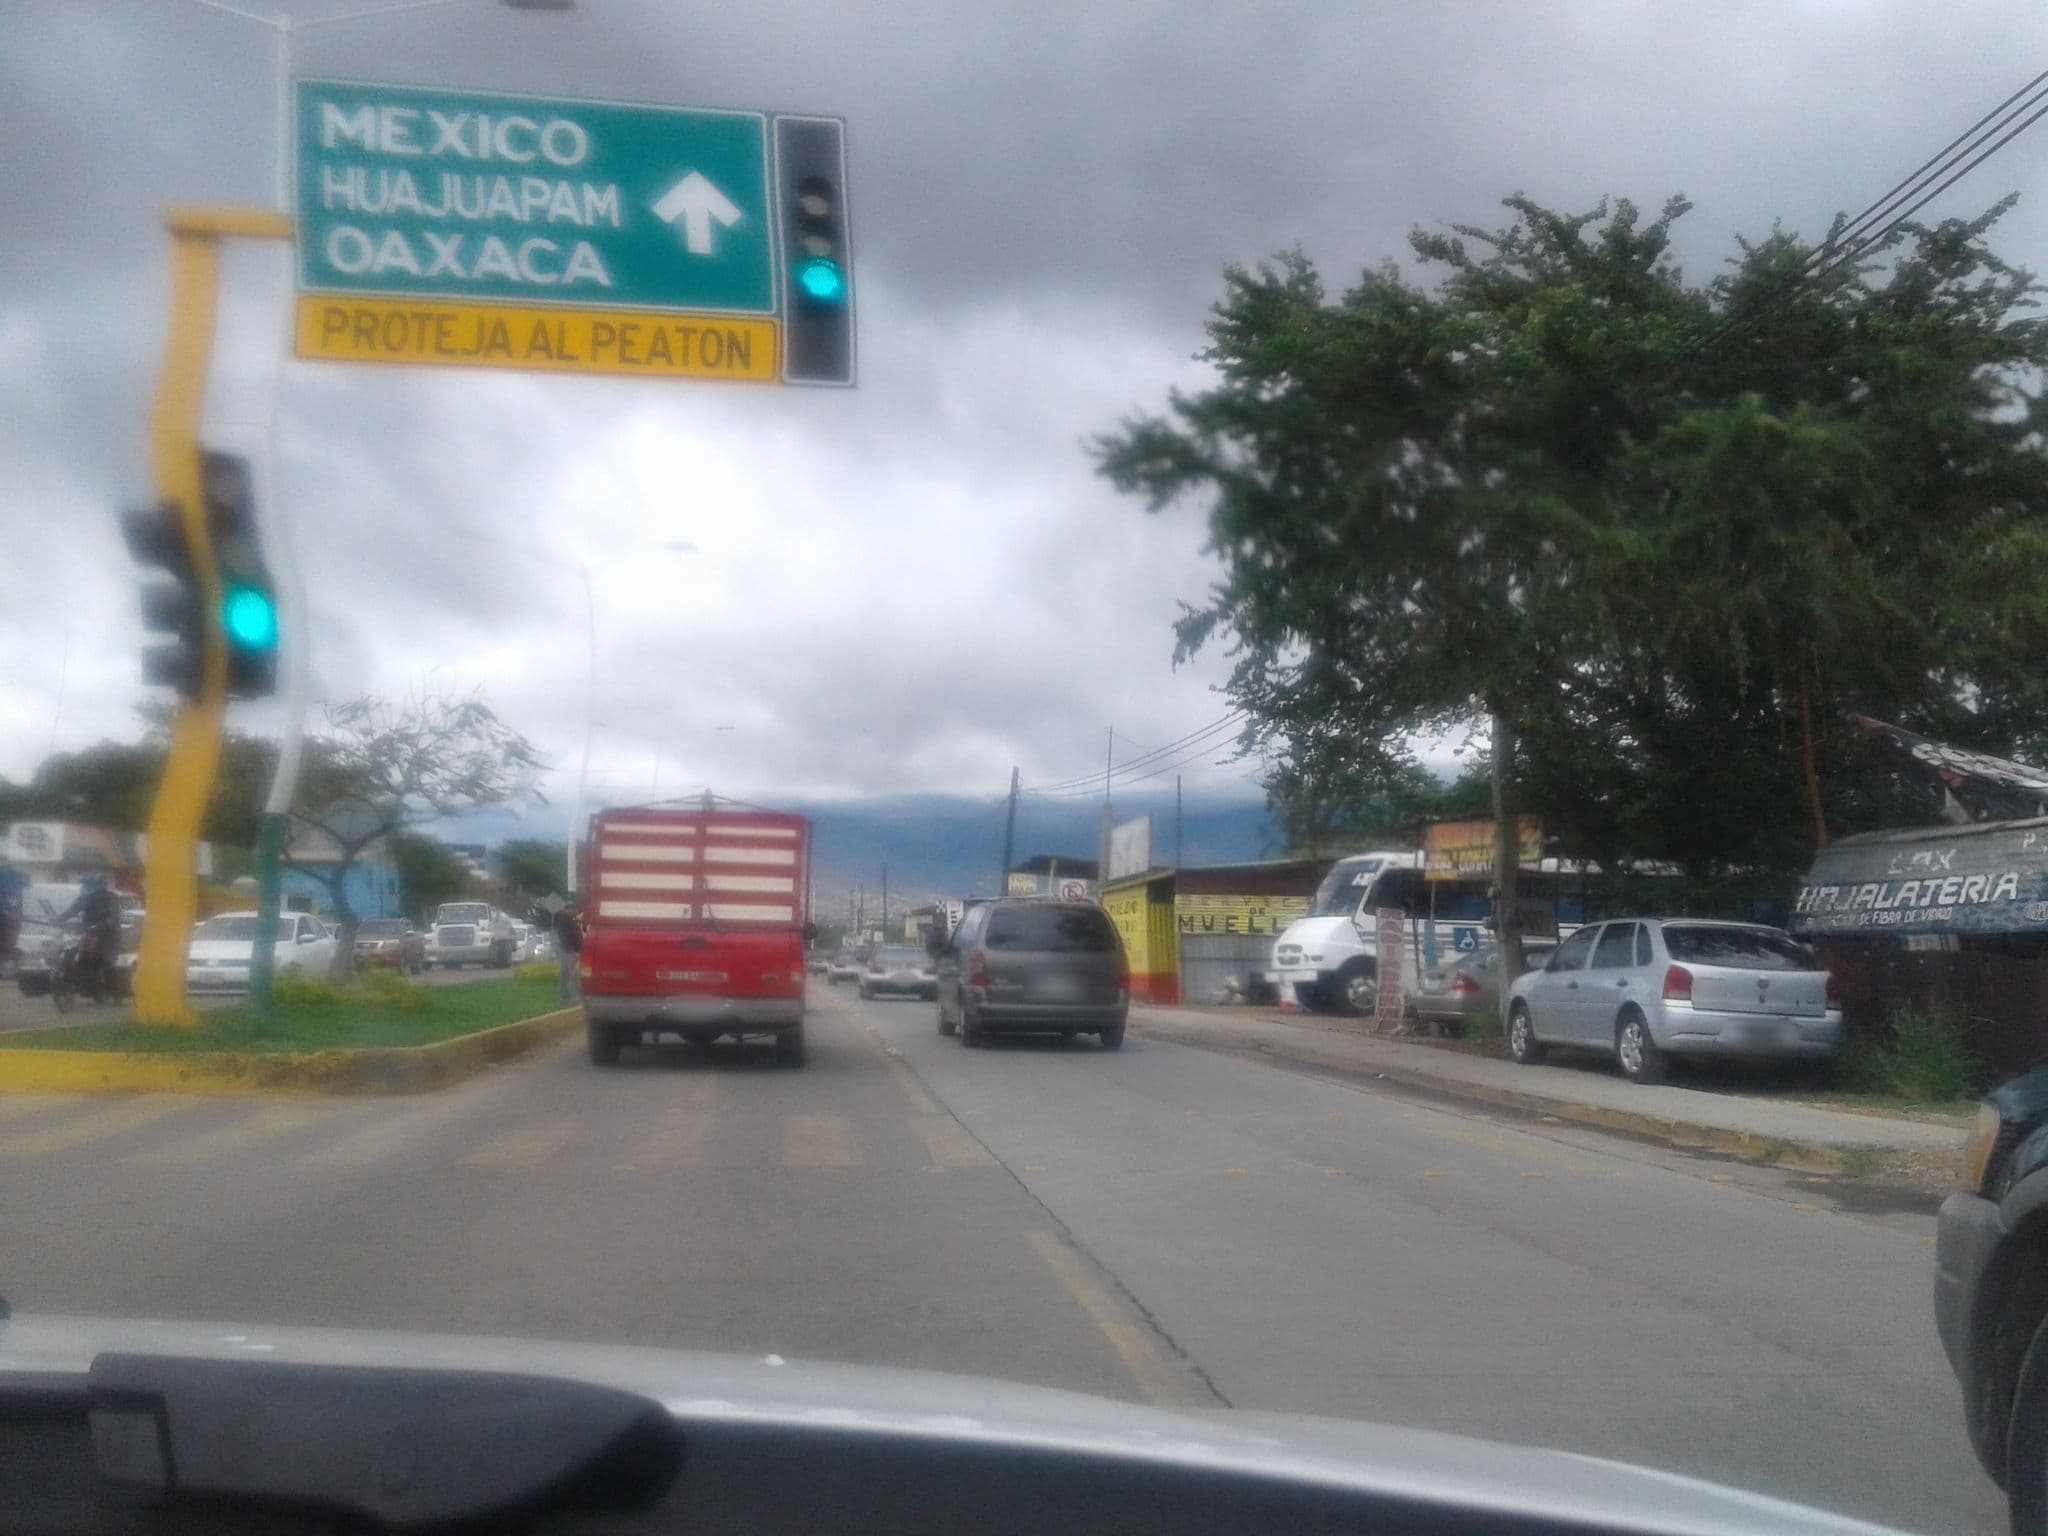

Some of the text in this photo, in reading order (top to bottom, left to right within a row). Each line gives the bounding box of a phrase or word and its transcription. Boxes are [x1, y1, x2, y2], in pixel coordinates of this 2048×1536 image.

[322, 103, 588, 166] MEXICO
[322, 165, 620, 227] HUAJUAPAM
[327, 227, 611, 286] OAXACA
[321, 307, 751, 370] PROTEJA AL PEATON
